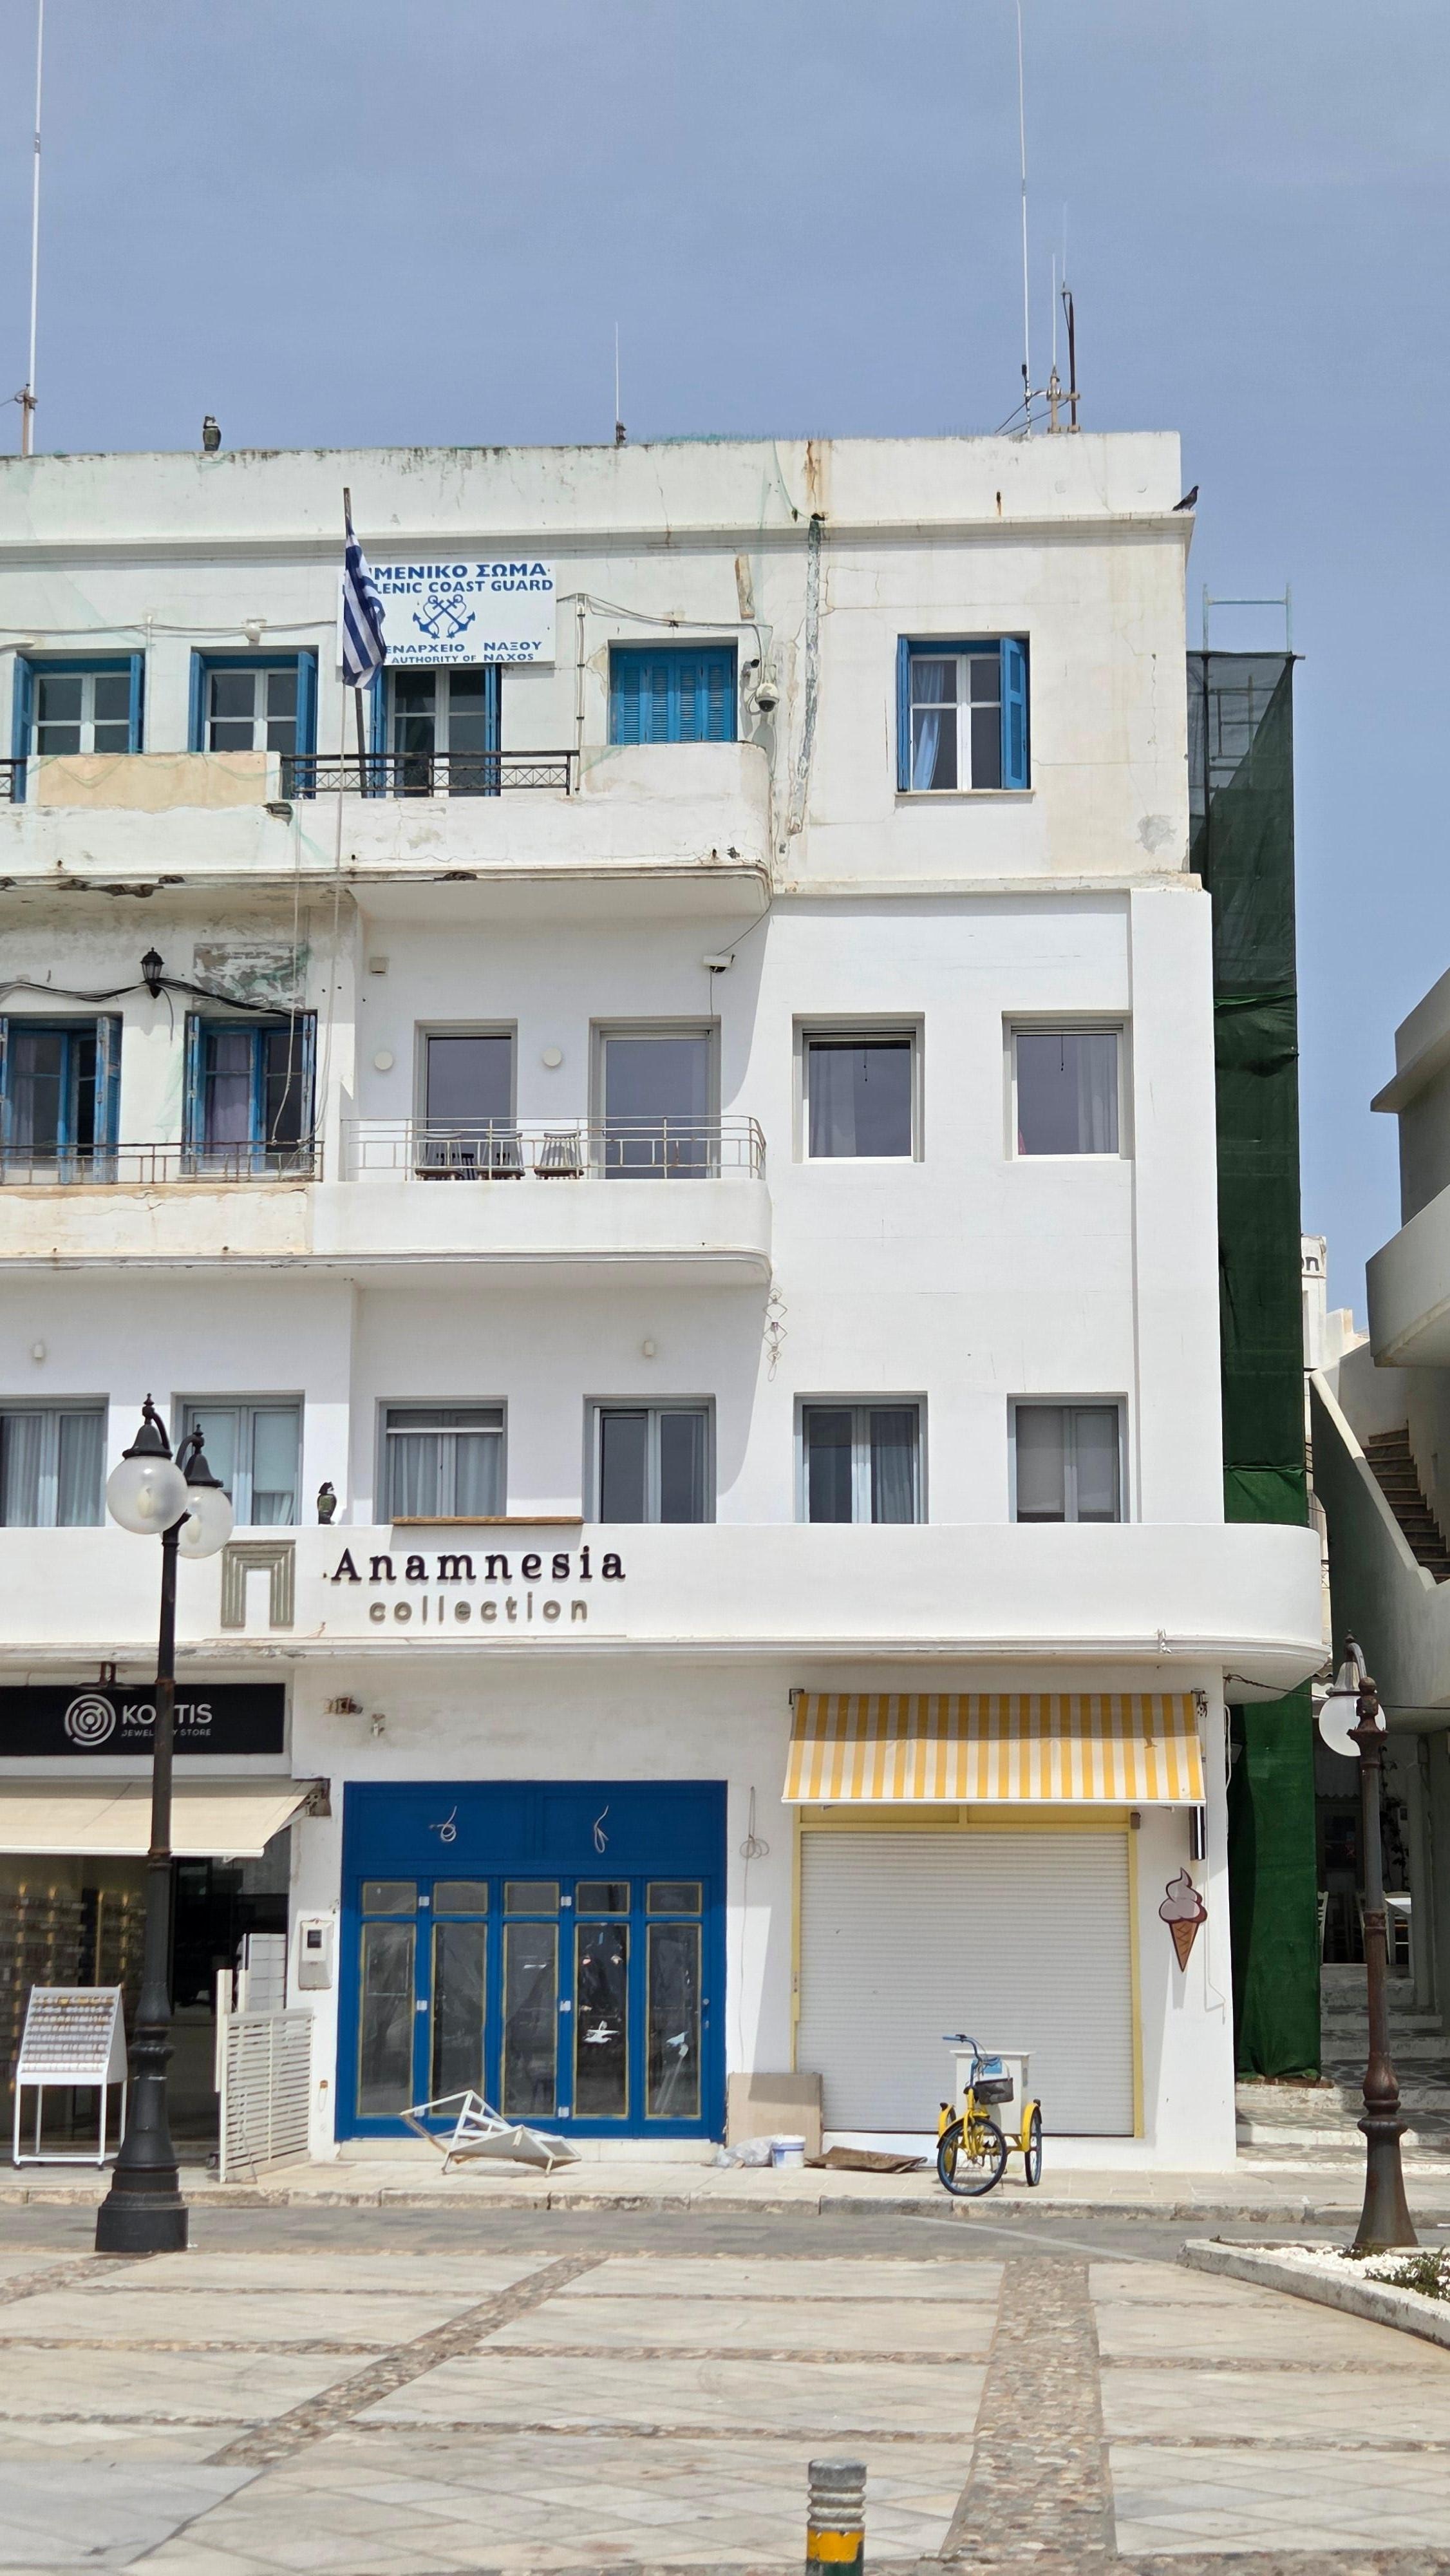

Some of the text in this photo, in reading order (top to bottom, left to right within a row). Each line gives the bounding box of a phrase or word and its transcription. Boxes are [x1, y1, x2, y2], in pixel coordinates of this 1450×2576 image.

[369, 563, 547, 580] ΜΕΝΙΚΟ ΣΩΜΑ
[428, 581, 485, 593] COAST
[491, 579, 554, 592] GUARD
[386, 641, 542, 654] ΕΝΑΡΧΕΙΟ ΝΑΞΟΥ
[391, 655, 458, 664] AUTHORITY
[484, 653, 534, 661] NAXOS
[331, 1545, 626, 1582] Anamnesia
[369, 1591, 587, 1622] collection
[122, 1703, 212, 1724] KOTIS
